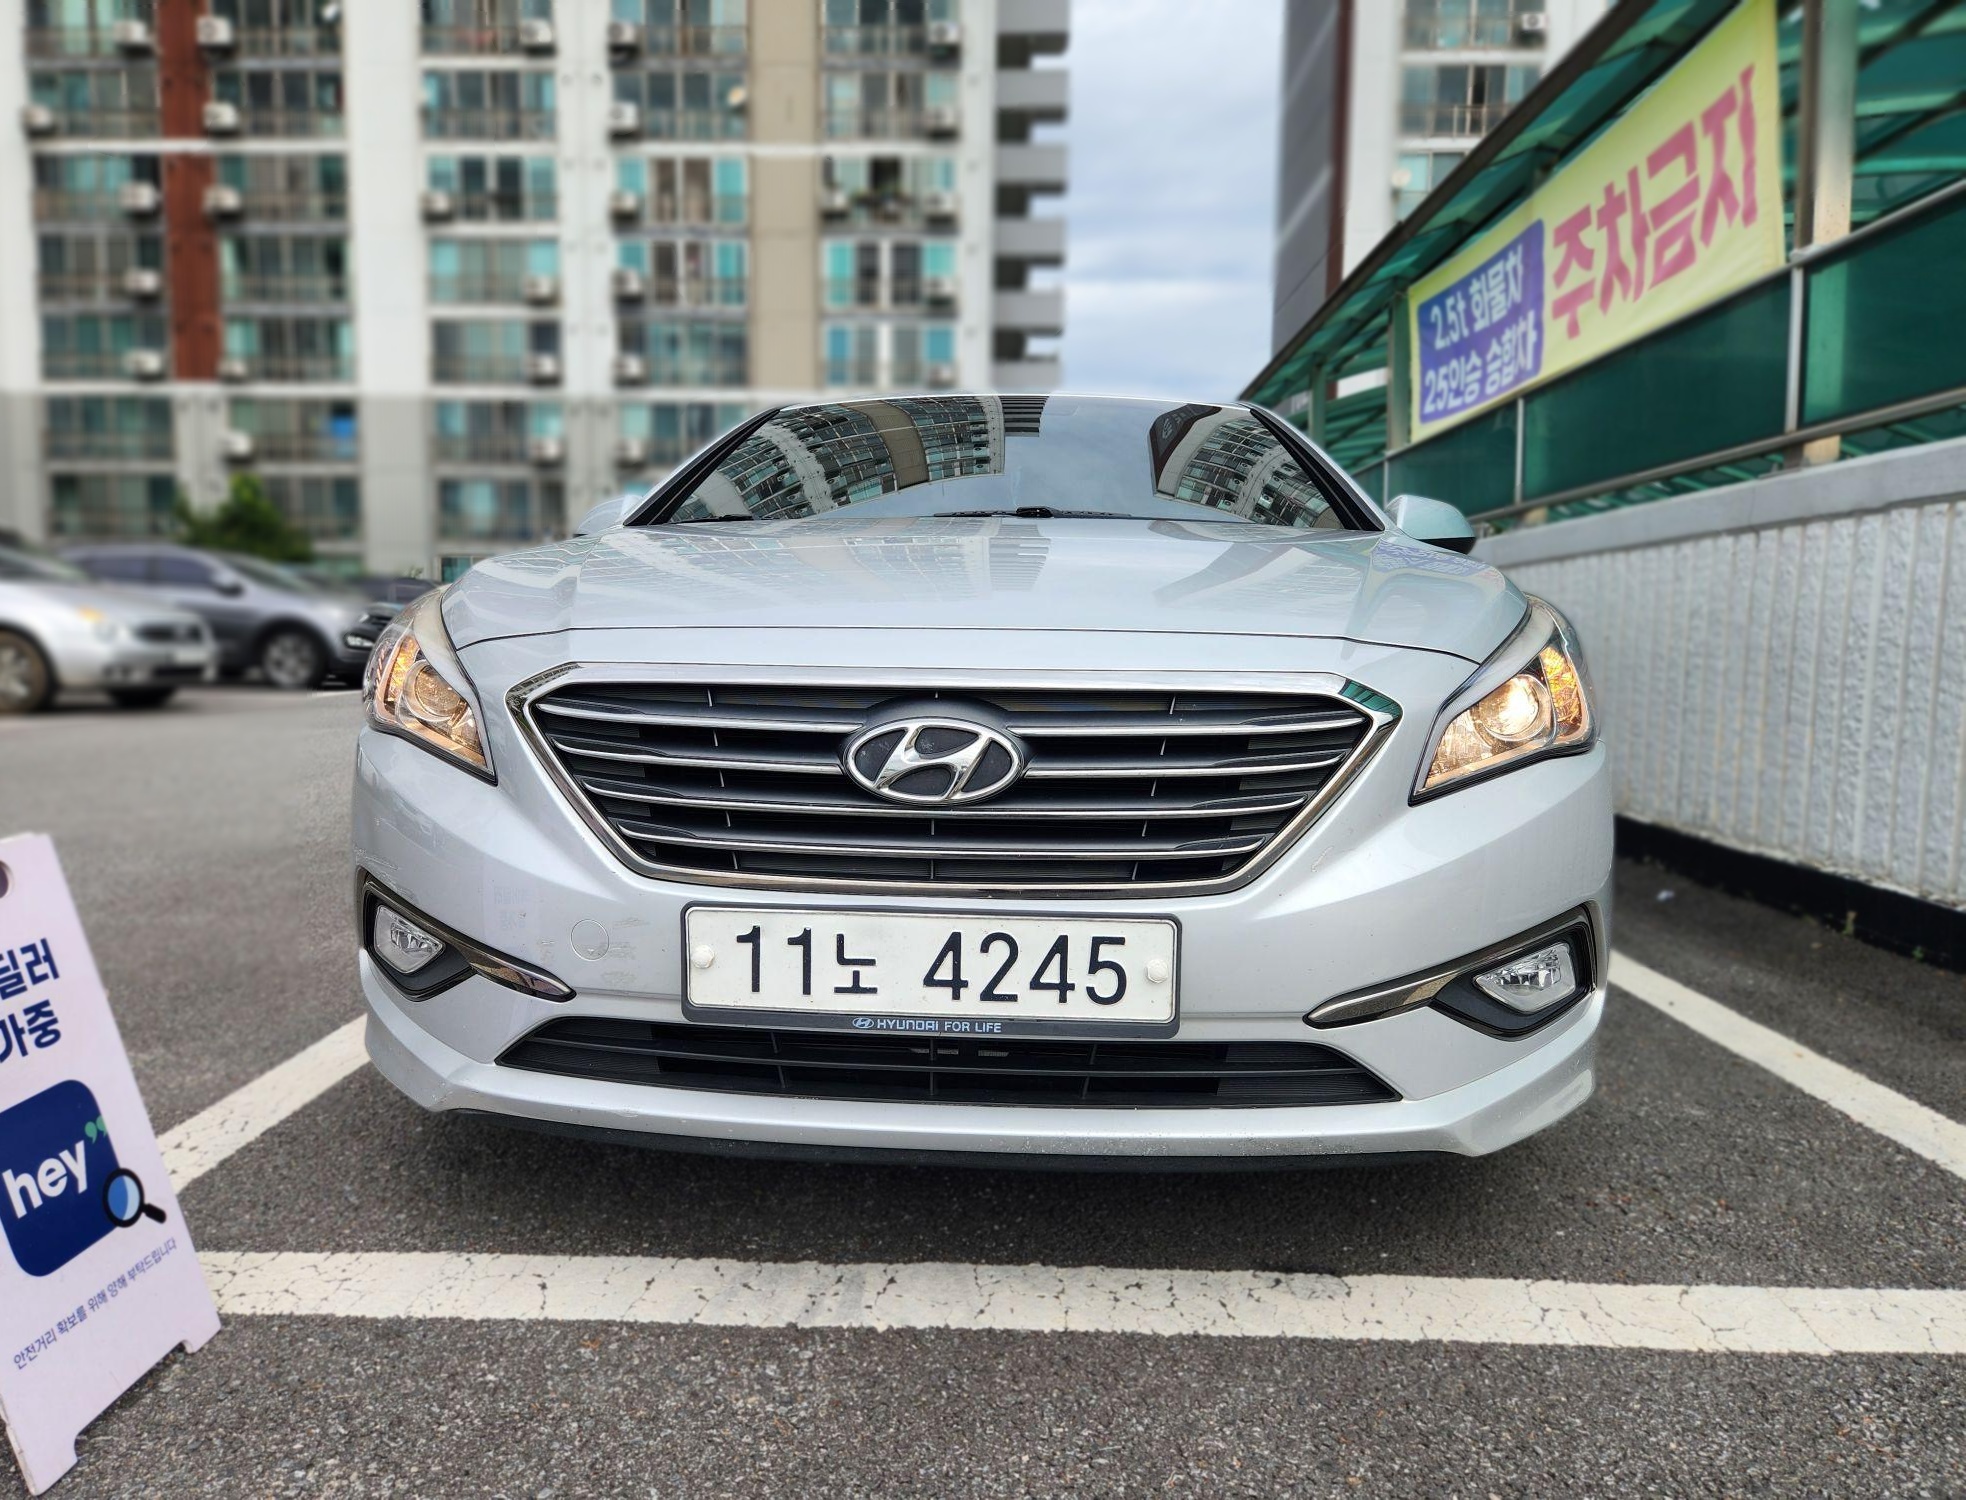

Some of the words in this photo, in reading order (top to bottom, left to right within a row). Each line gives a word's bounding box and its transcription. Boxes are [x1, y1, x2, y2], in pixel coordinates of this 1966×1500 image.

[1552, 63, 1758, 341] 주차금지
[1430, 291, 1469, 350] 2.5t
[1469, 244, 1523, 333] 화물차
[1423, 350, 1482, 414] 25인승
[1485, 309, 1538, 395] 승합차
[0, 937, 60, 1000] 딜러
[736, 925, 878, 996] 11노
[922, 931, 1127, 1006] 4245
[0, 999, 62, 1063] 가중
[877, 1018, 938, 1031] HYUNDAI
[944, 1021, 970, 1032] FOR
[975, 1022, 1001, 1033] LIFE
[13, 1328, 57, 1370] 안전거리
[56, 1305, 88, 1335] 확보를
[87, 1289, 108, 1312] 위해
[107, 1274, 128, 1298] 양해
[127, 1237, 177, 1281] 부탁드립니다
